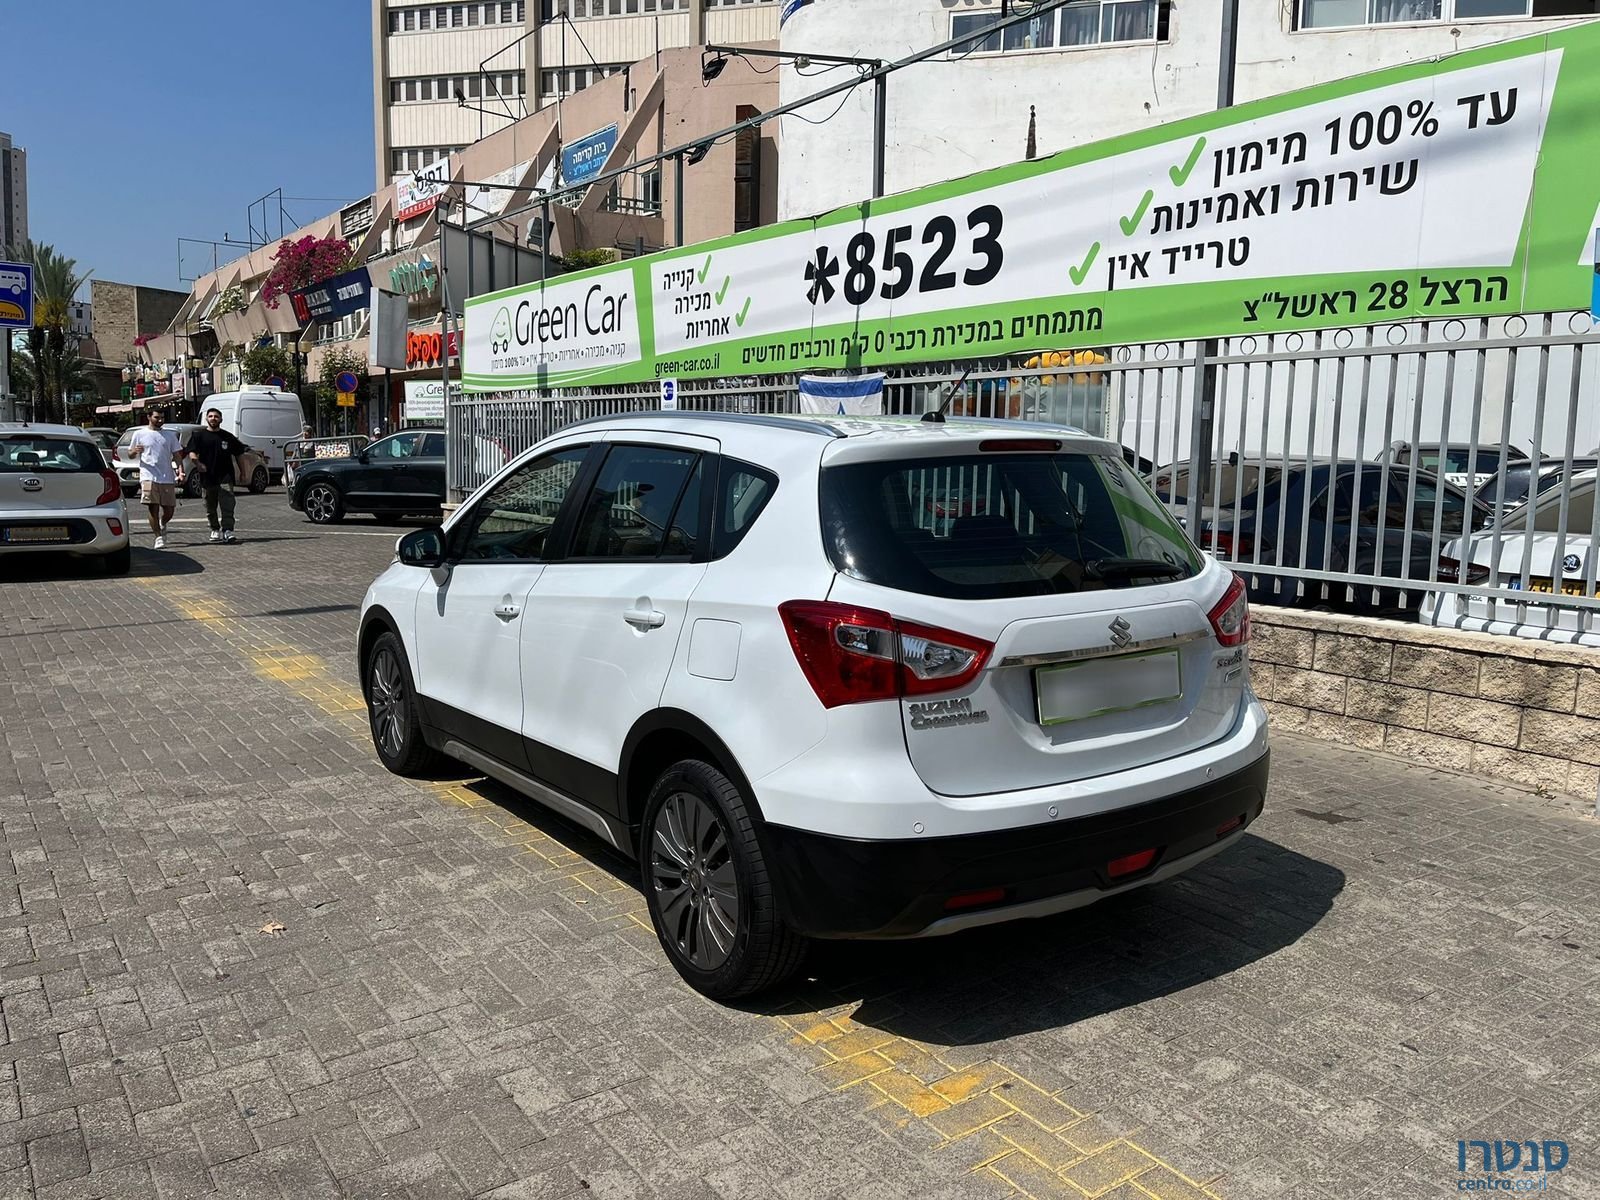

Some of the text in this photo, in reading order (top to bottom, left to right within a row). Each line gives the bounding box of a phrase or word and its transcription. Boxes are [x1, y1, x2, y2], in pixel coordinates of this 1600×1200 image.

[1212, 86, 1519, 188] עד 100% מימון
[572, 141, 607, 165] בית קדימה
[1149, 157, 1419, 236] שירות ואמינות
[1106, 235, 1250, 292] טרייד אין
[663, 267, 694, 291] קנייה
[1420, 273, 1510, 309] הרצל
[674, 291, 711, 315] מכירה
[1367, 279, 1409, 312] 28
[515, 284, 628, 347] Green Car
[1011, 306, 1103, 339] מתמחים
[685, 316, 730, 340] אחריות
[931, 318, 1004, 348] במכירת
[610, 342, 626, 358] קניה
[741, 342, 786, 364] חדשים
[790, 338, 835, 359] ורכבים
[874, 330, 885, 352] 0
[889, 330, 927, 352] רכבי
[505, 357, 519, 368] 100%
[655, 352, 720, 377] green-car.co.il
[909, 698, 972, 716] SUZUKI
